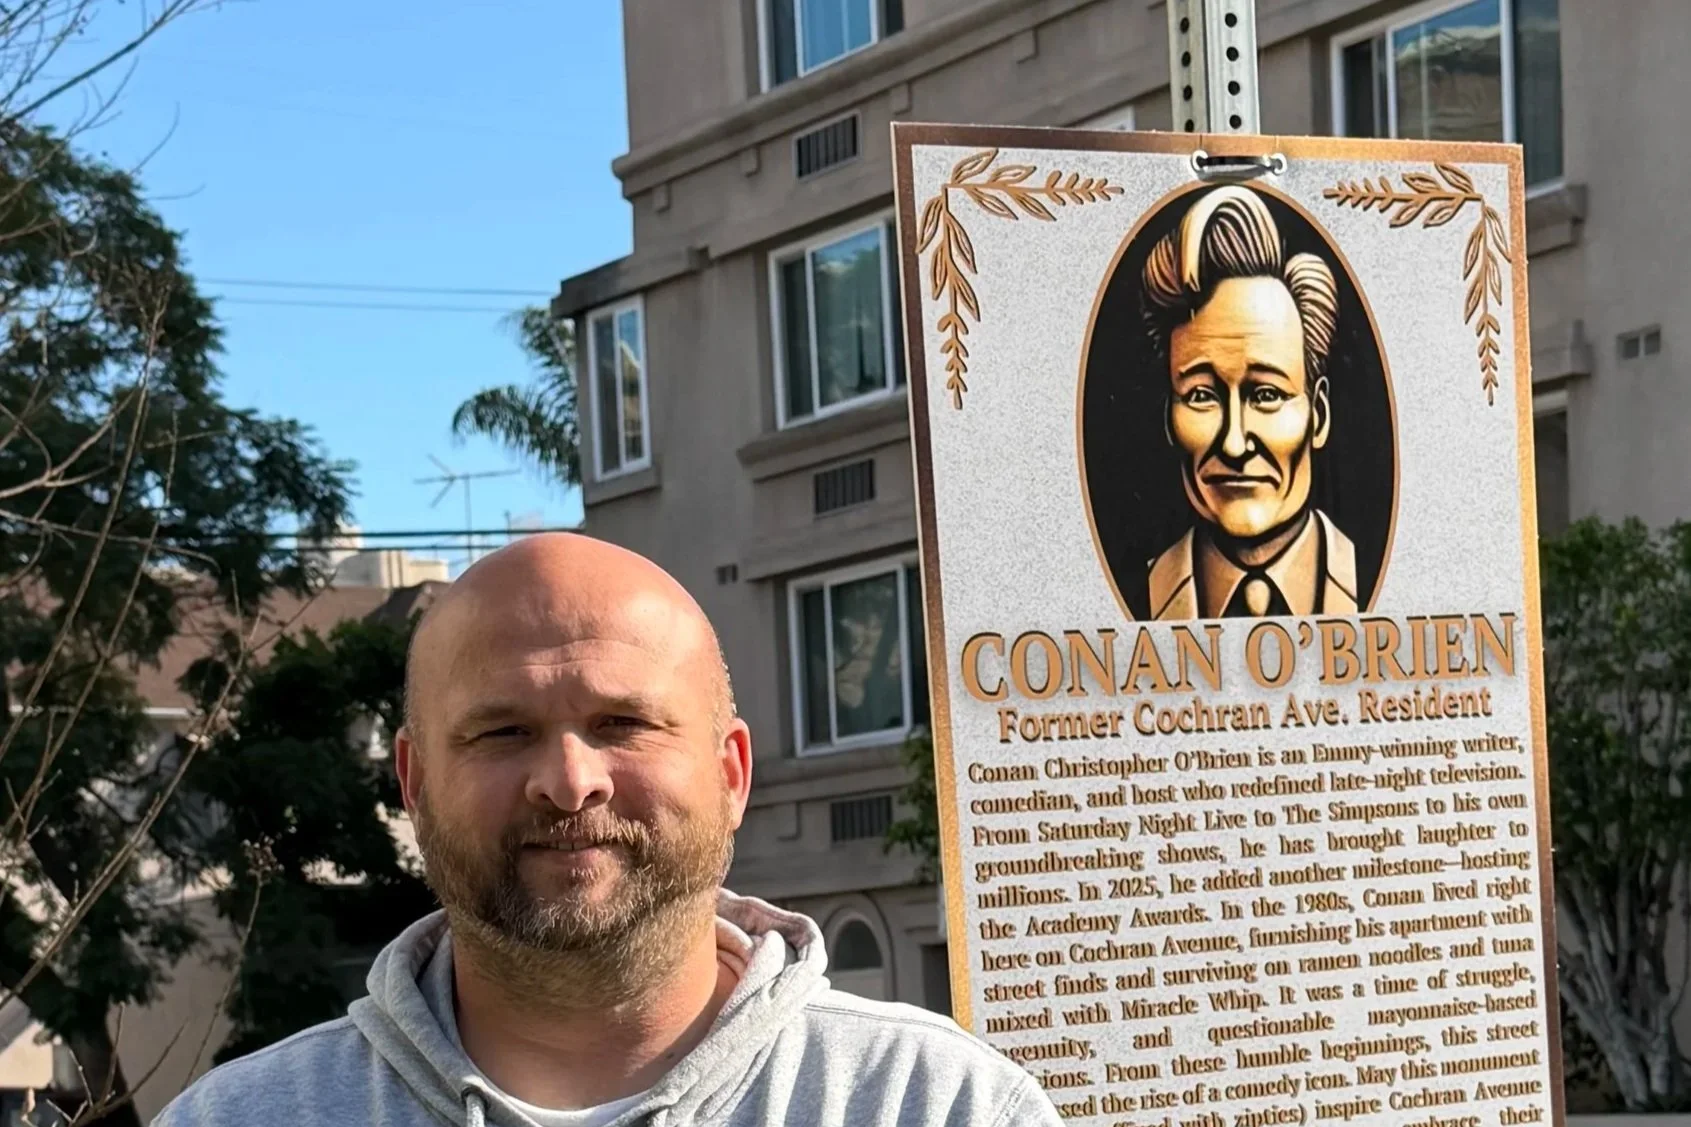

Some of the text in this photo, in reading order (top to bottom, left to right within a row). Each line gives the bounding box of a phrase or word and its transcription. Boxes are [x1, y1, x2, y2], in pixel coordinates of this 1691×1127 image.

[960, 611, 1518, 703] CONAN O'BRIEN
[997, 685, 1493, 745] Former Cochran Ave. Resident
[967, 732, 1524, 784] Conan Christopher O'Brien is an Emmy-winning writer,
[970, 761, 1525, 816] comedian, and host who redefined late-night television.
[972, 792, 1526, 847] From Saturday Night Live to The Simpsons to his own
[975, 820, 1528, 884] groundbreaking shows, he has brought laughter to
[977, 885, 1071, 910] millions.
[1077, 881, 1102, 902] In
[1108, 876, 1164, 899] 2025,
[1169, 873, 1197, 895] he
[1202, 866, 1264, 892] added
[1268, 862, 1347, 886] another
[979, 875, 1531, 941] the Academy Awards. In the 1980s, Conan lived right
[980, 903, 1533, 972] here on Cochran Avenue, furnishing his apartment with
[984, 936, 1534, 1003] street finds and surviving on ramen noodles and tuna
[986, 962, 1535, 1034] mixed with Miracle Whip. It was a time of struggle,
[1132, 1025, 1173, 1050] and
[1207, 1010, 1335, 1047] questionable
[1367, 989, 1537, 1027] mayonnaise-based
[1100, 1092, 1137, 1115] the
[1140, 1088, 1180, 1111] rise
[1182, 1082, 1206, 1106] of
[1208, 1087, 1222, 1103] a
[1224, 1073, 1301, 1101] comedy
[1304, 1071, 1352, 1092] icon.
[1356, 1065, 1397, 1087] May
[1400, 1058, 1438, 1081] this
[1440, 1049, 1539, 1076] monument
[1105, 1063, 1161, 1084] From
[1171, 1054, 1226, 1077] these
[1236, 1042, 1312, 1070] humble
[1320, 1033, 1432, 1063] beginnings,
[1441, 1025, 1478, 1047] this
[1486, 1020, 1538, 1042] street
[1315, 1096, 1382, 1122] inspire
[1389, 1087, 1467, 1111] Cochran
[1474, 1081, 1542, 1101] Avenue
[1499, 1104, 1543, 1126] their
